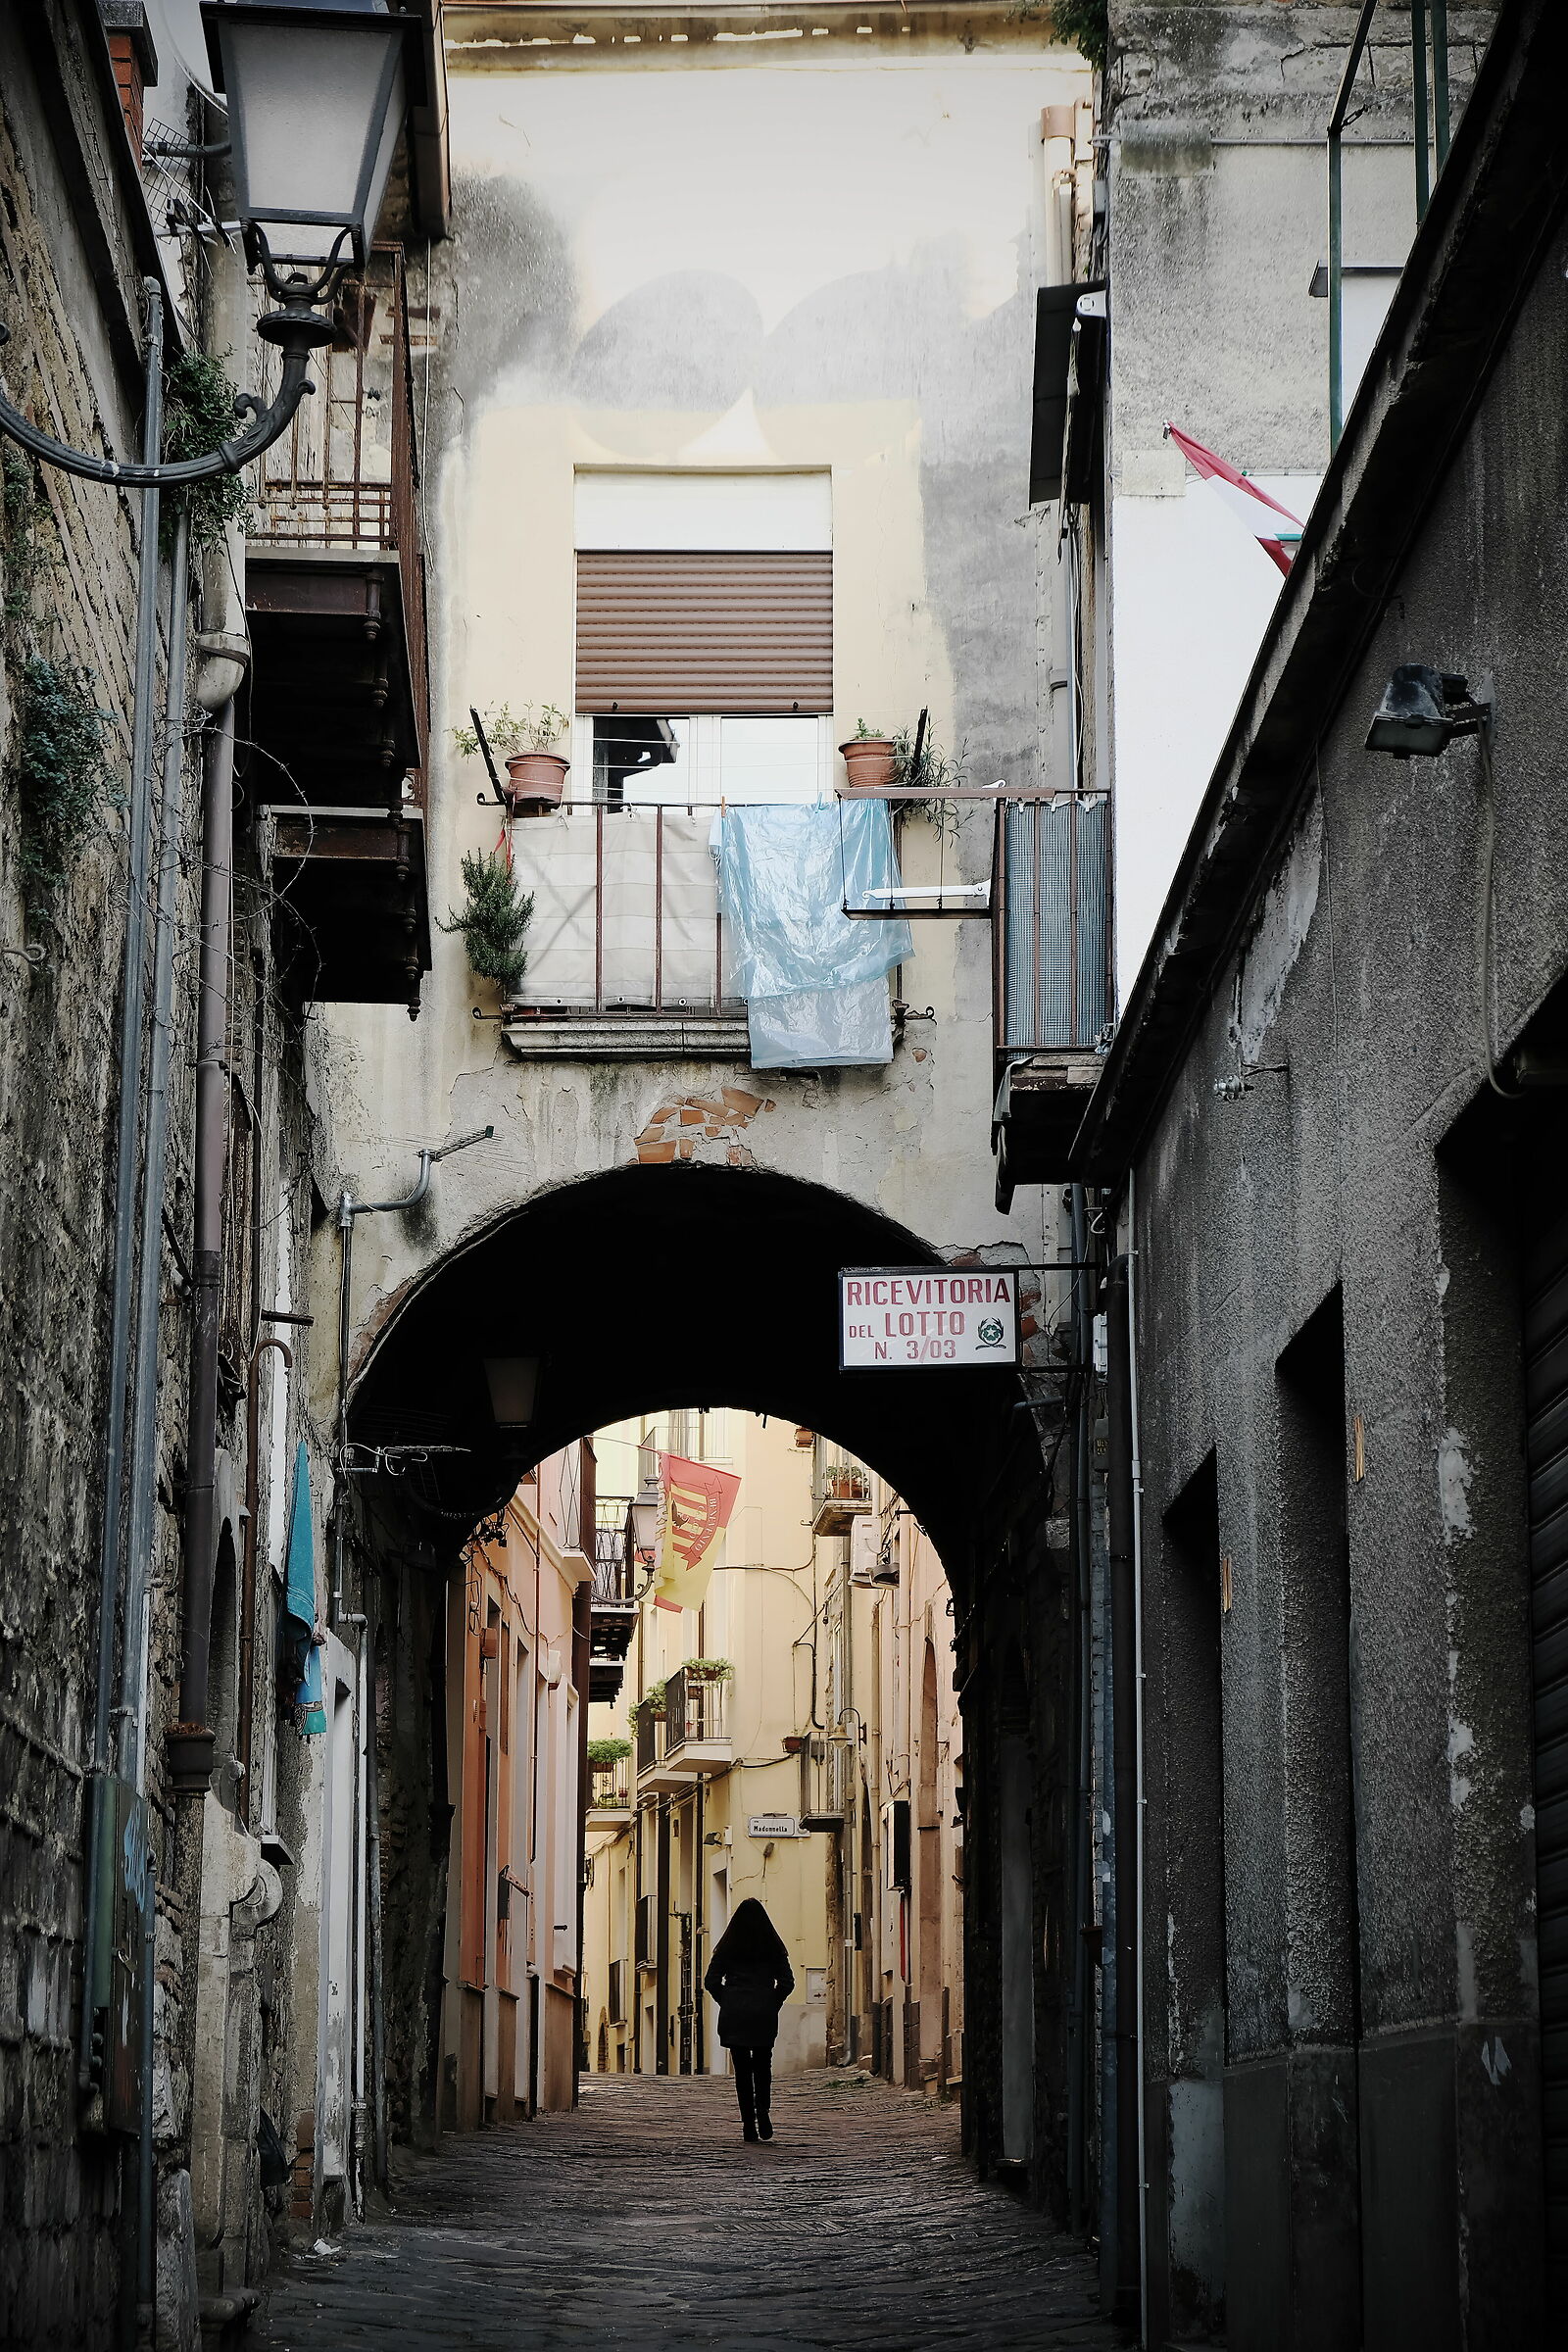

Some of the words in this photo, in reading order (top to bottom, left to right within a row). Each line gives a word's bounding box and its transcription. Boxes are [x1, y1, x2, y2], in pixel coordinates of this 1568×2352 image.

[847, 1278, 1011, 1305] RICEVITORIA
[849, 1324, 874, 1338] DEL
[885, 1310, 965, 1338] LOTTO
[874, 1342, 893, 1360] N.
[906, 1336, 956, 1363] 3/03
